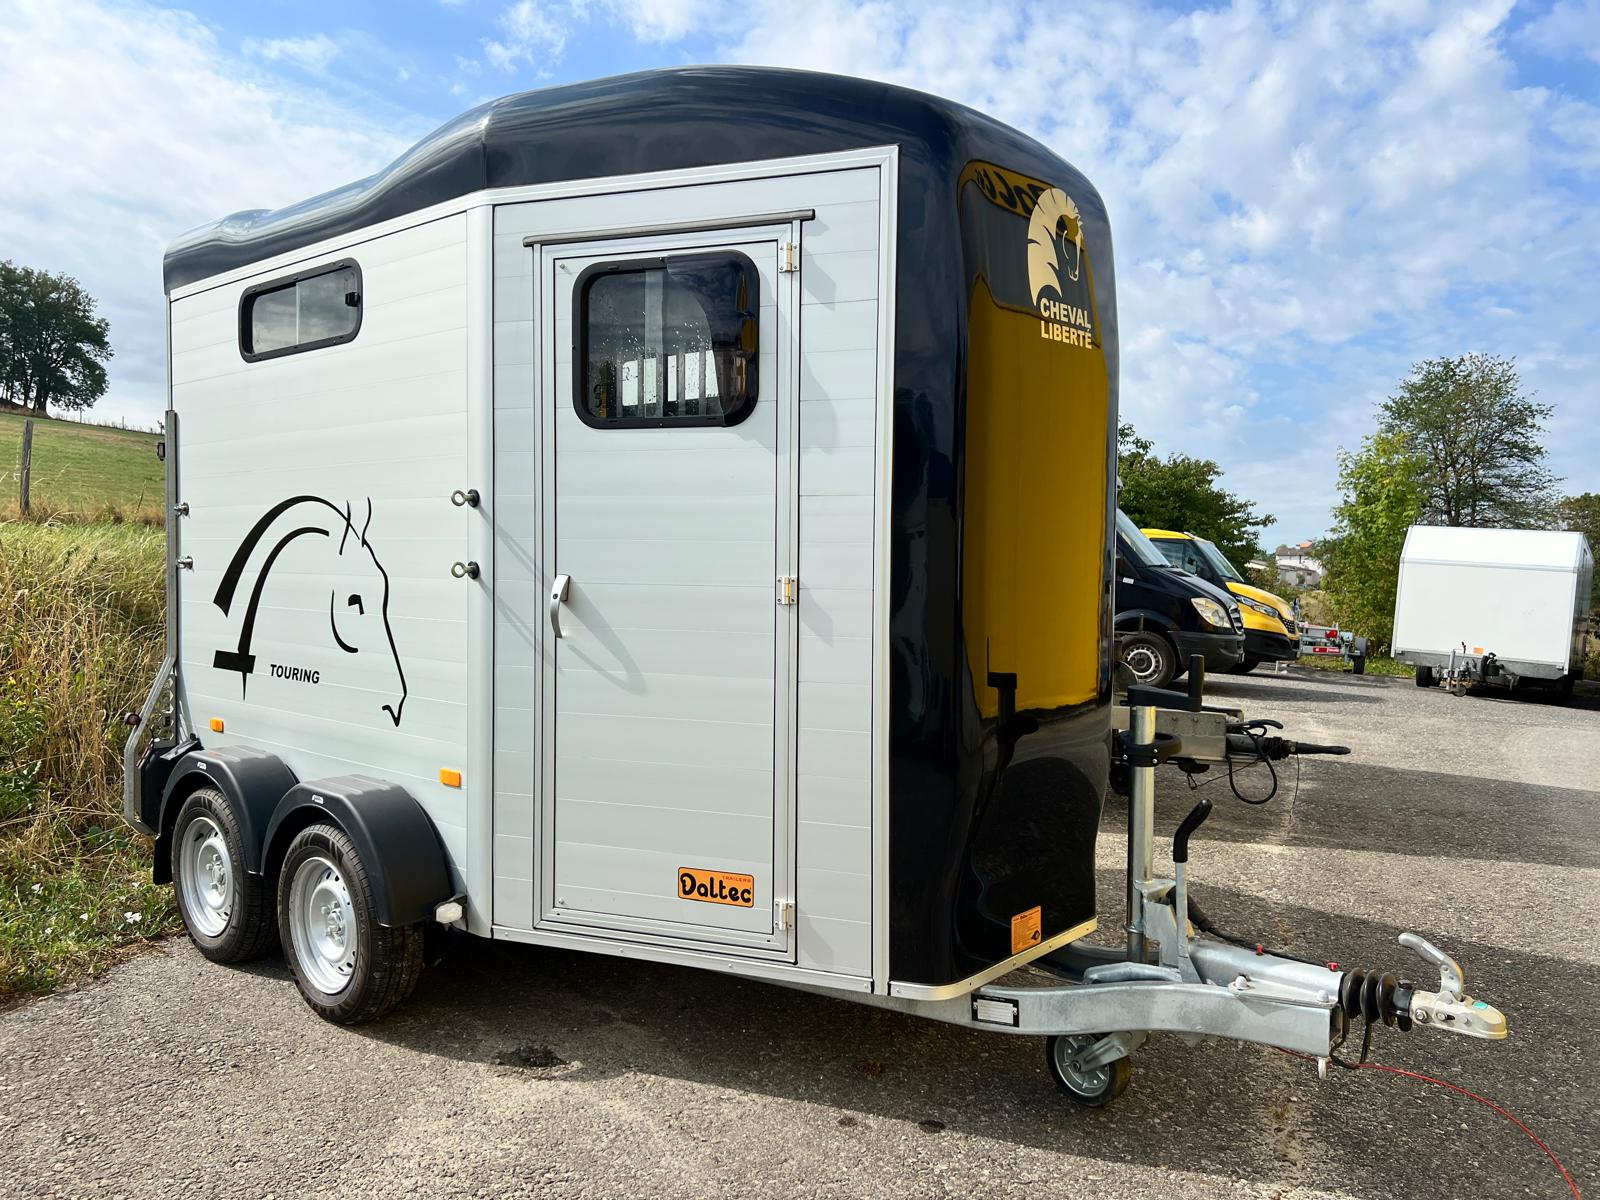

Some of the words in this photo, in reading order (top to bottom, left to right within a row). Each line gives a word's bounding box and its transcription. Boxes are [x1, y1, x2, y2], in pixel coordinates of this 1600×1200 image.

[1040, 297, 1091, 329] CHEVAL
[1040, 320, 1092, 349] LIBERTÉ
[270, 663, 320, 684] TOURING
[680, 872, 752, 904] Daltec
